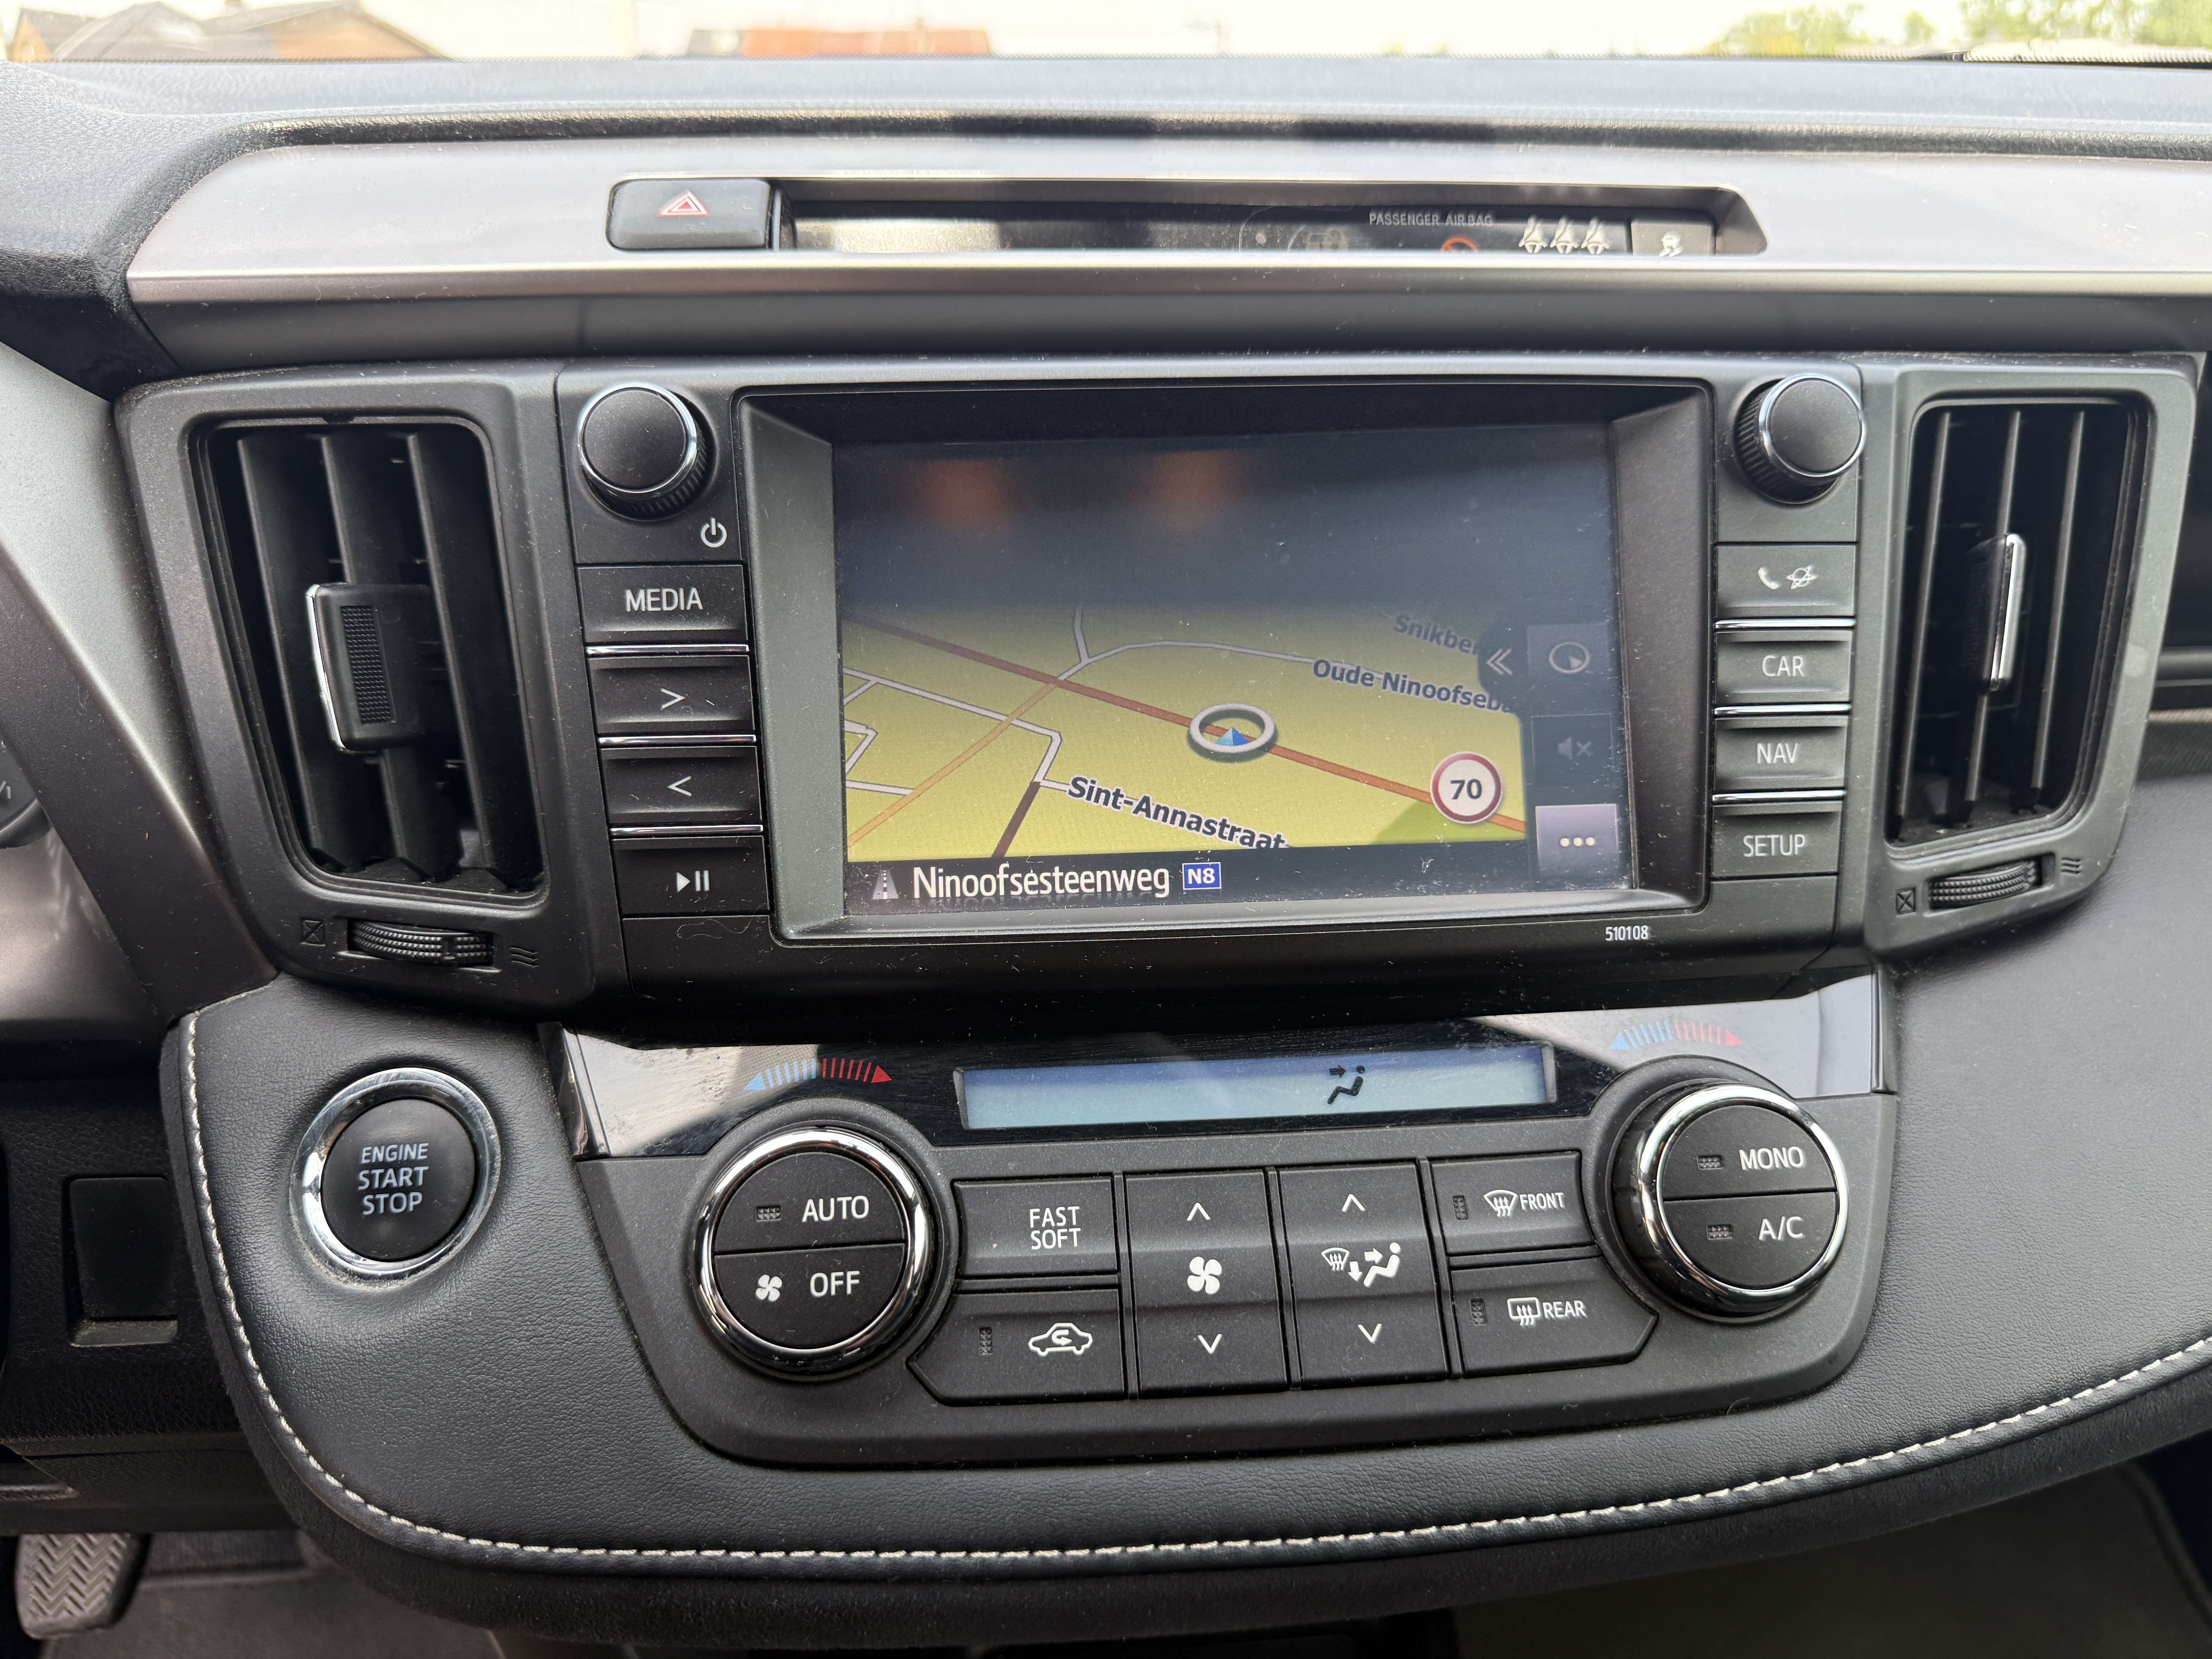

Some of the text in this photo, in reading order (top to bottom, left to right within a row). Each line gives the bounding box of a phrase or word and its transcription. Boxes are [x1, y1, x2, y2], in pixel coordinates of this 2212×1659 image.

[1369, 213, 1439, 226] PASSENGER
[626, 588, 703, 611] MEDIA
[1313, 659, 1374, 687] Oude
[1762, 655, 1805, 677] CAR
[1757, 743, 1798, 764] NAV
[1451, 779, 1482, 799] 70
[1068, 776, 1285, 849] Sint-Annastraat
[1743, 834, 1808, 857] SETUP
[914, 863, 1168, 897] Ninoofsesteenweg
[1188, 868, 1215, 884] N8
[1606, 925, 1649, 941] 510108
[362, 1143, 429, 1163] ENGINE
[1739, 1147, 1806, 1170] MONO
[359, 1166, 429, 1190] START
[363, 1192, 422, 1215] STOP
[802, 1195, 869, 1222] AUTO
[1520, 1193, 1564, 1210] FRONT
[1030, 1206, 1079, 1227] FAST
[1031, 1228, 1080, 1250] SOFT
[1759, 1216, 1804, 1240] A/C
[811, 1271, 859, 1297] OFF
[1543, 1300, 1586, 1318] REAR
